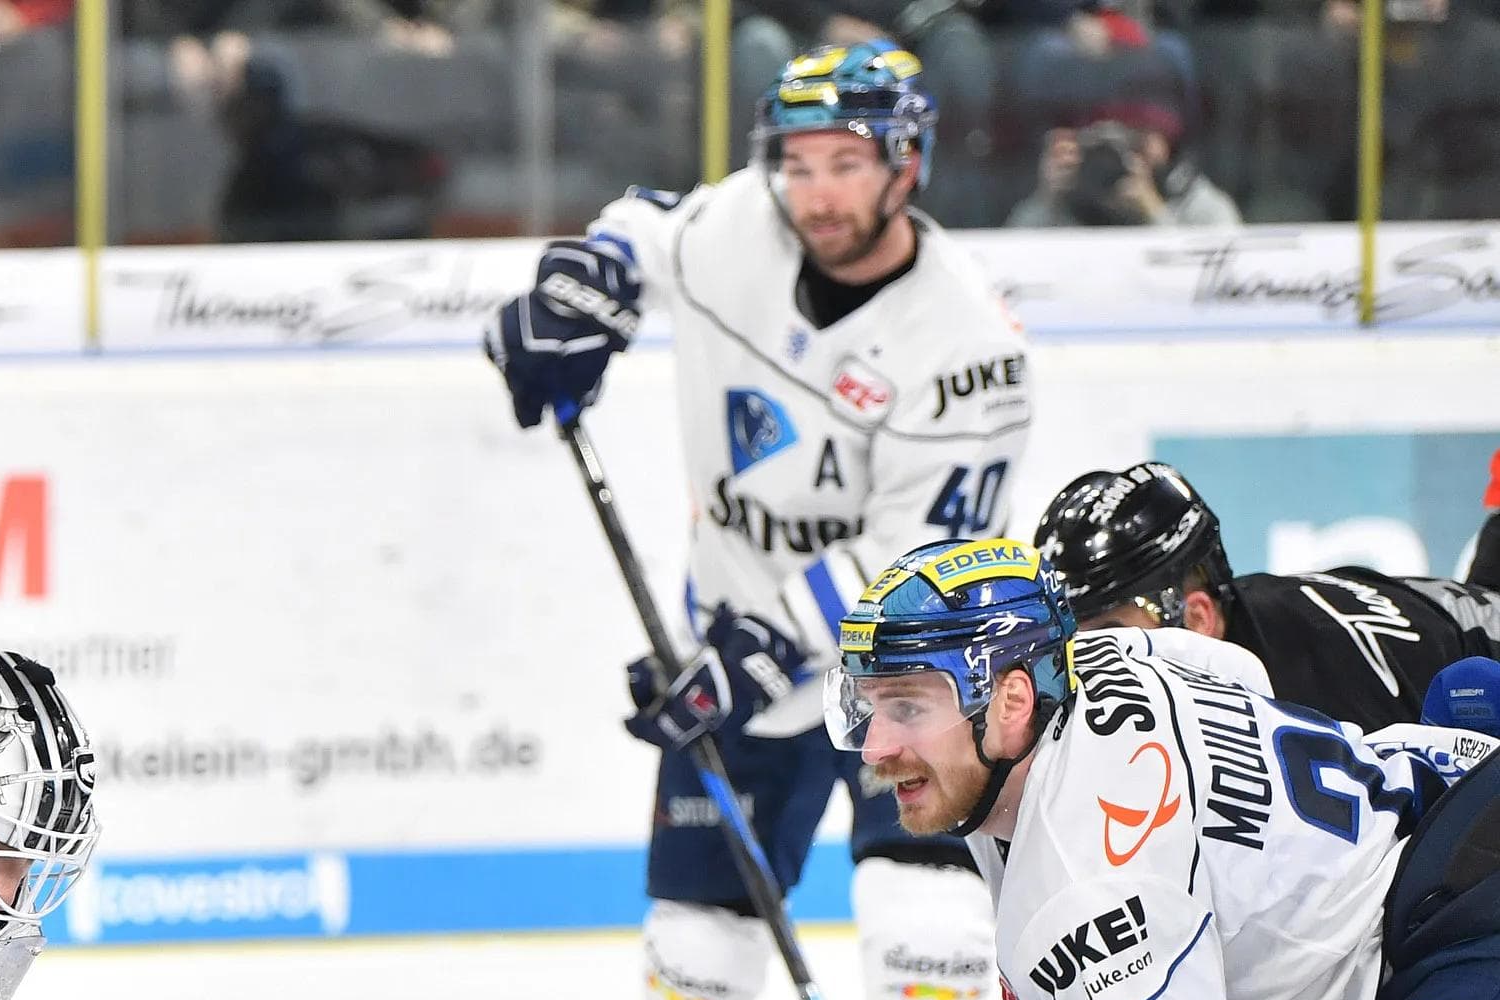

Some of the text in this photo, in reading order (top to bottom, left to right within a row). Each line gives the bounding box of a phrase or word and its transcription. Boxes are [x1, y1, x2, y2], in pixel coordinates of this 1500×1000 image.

[814, 436, 846, 490] A
[708, 476, 866, 554] SATUR
[925, 459, 1010, 540] 40
[935, 546, 1028, 576] EDEKA
